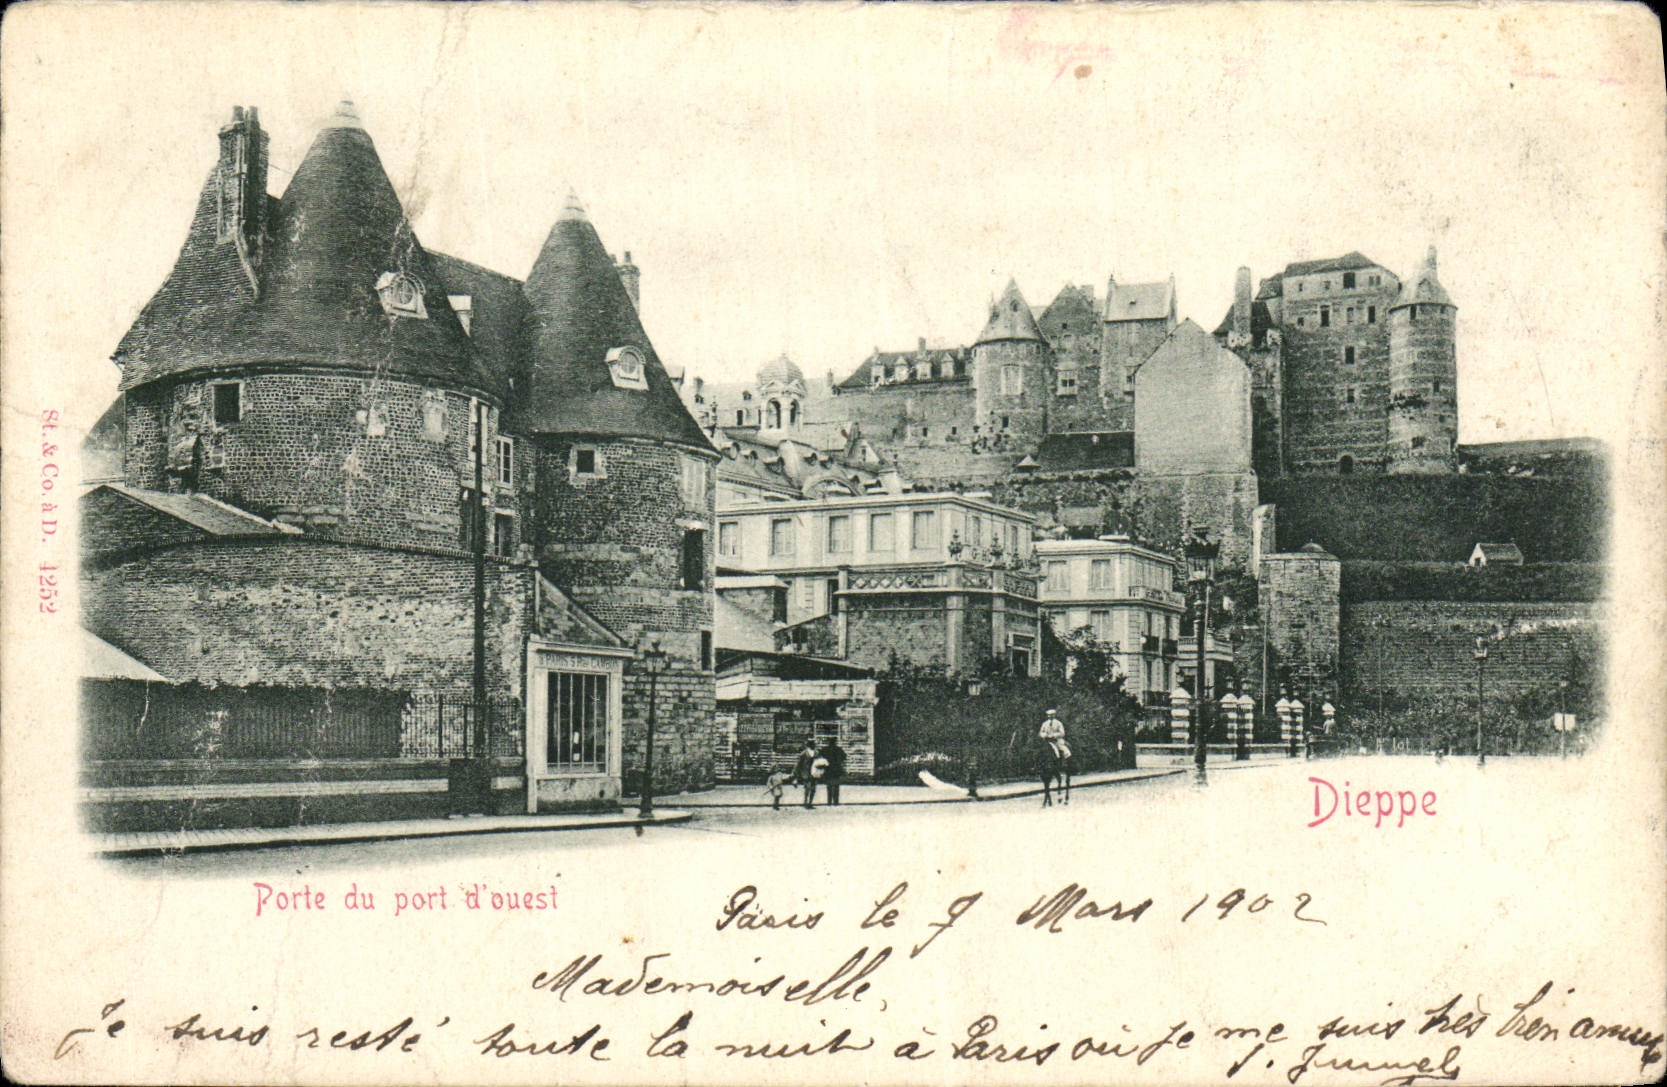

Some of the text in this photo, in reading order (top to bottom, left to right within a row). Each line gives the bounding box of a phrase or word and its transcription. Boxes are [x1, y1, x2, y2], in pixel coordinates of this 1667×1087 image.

[716, 885, 824, 931] Paris
[861, 881, 907, 930] le
[1016, 883, 1153, 933] Mars
[1181, 888, 1327, 925] 1902
[164, 1005, 269, 1046] suis
[296, 1016, 450, 1052] resté
[474, 1023, 610, 1060] toute
[647, 1010, 693, 1058] la
[715, 1019, 874, 1058] nuit
[894, 1027, 936, 1060] à
[952, 1015, 1060, 1066] Paris
[1072, 1024, 1138, 1060] où
[1214, 1023, 1287, 1046] me
[1318, 1002, 1405, 1040] suis
[1419, 994, 1490, 1038] très
[1496, 981, 1578, 1041] bien
